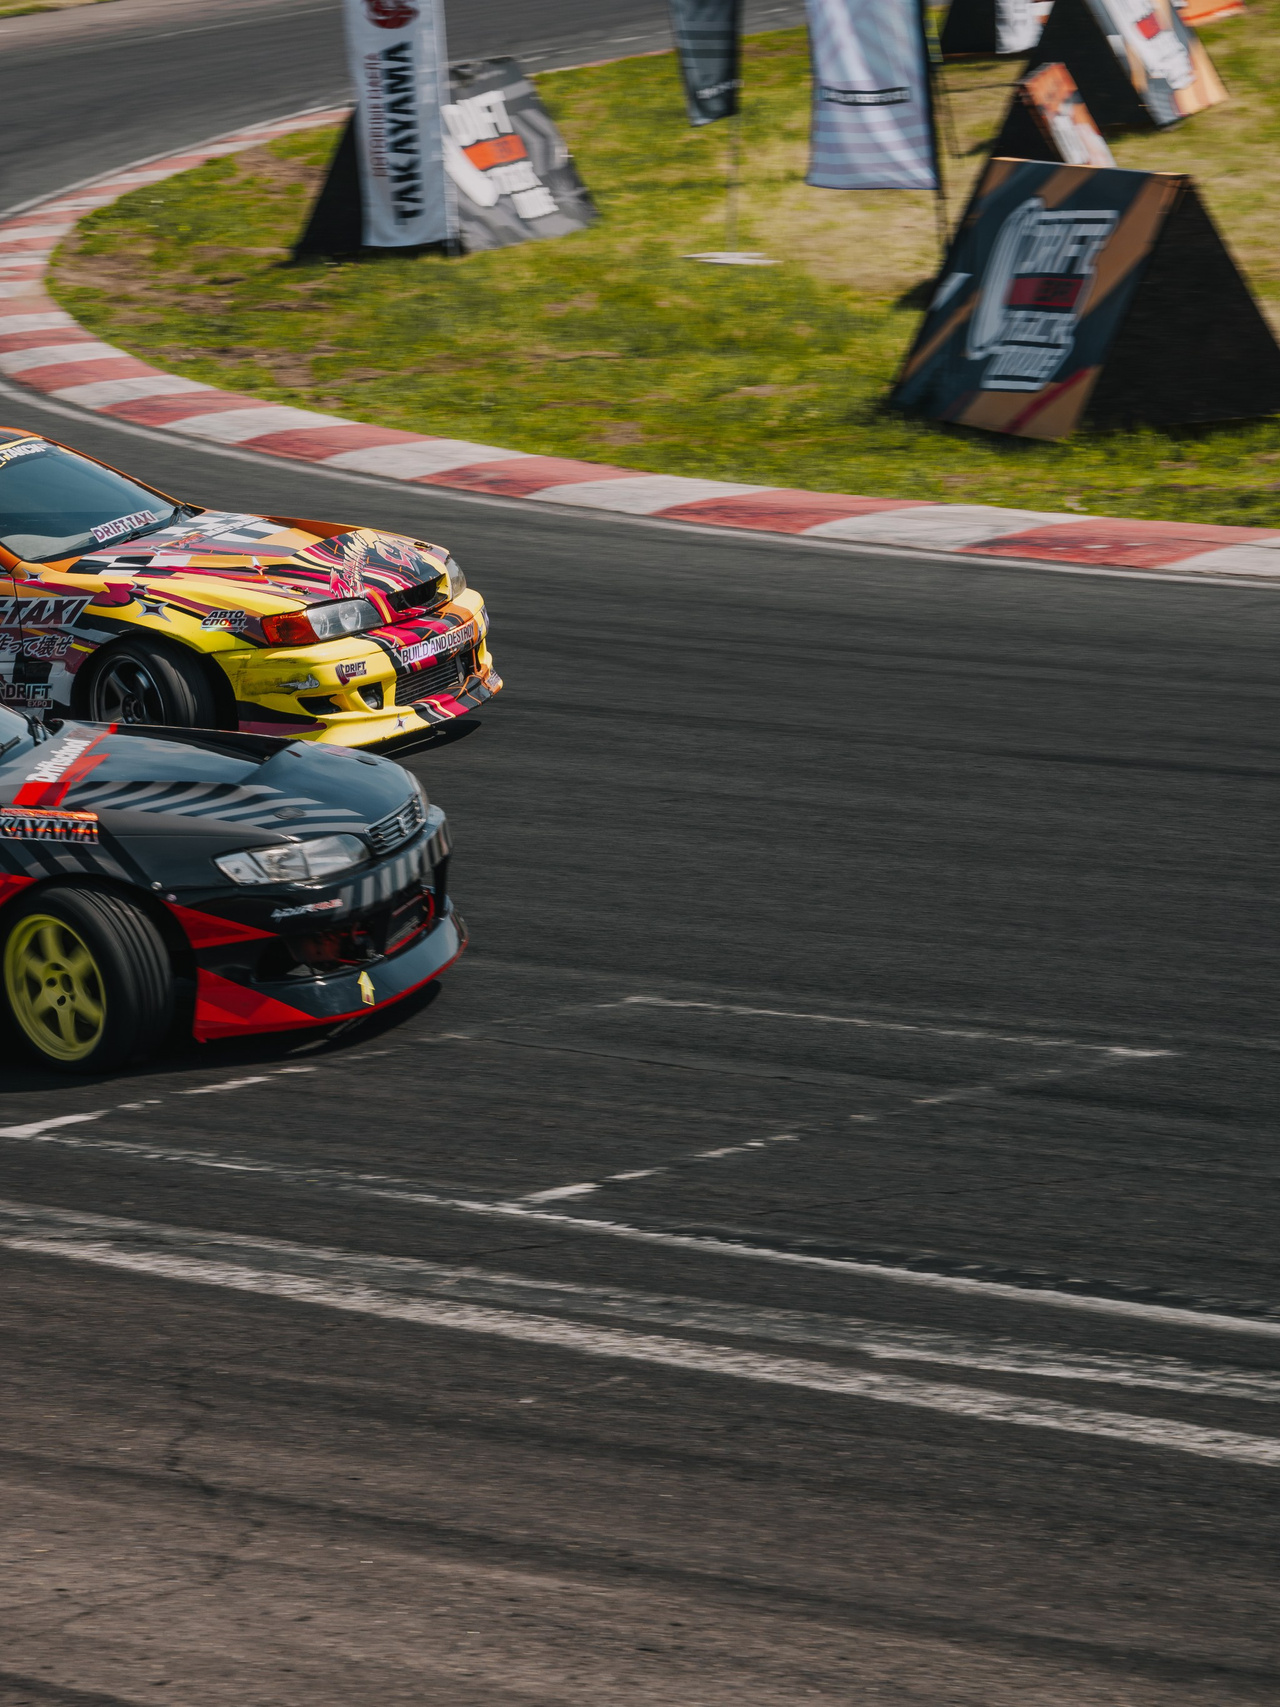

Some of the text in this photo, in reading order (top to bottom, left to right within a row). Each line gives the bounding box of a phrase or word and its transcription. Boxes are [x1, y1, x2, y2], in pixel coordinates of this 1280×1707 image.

[382, 41, 426, 226] TAKAYAMA
[93, 511, 157, 541] DRIFT TAXI
[3, 597, 90, 628] TAXI
[207, 610, 245, 619] АВТО
[201, 618, 246, 627] СПОРТ
[402, 642, 429, 664] BUILD
[430, 634, 448, 656] AND
[345, 661, 366, 673] DRIFT
[5, 684, 53, 700] DRIFT
[27, 700, 48, 708] EXPO
